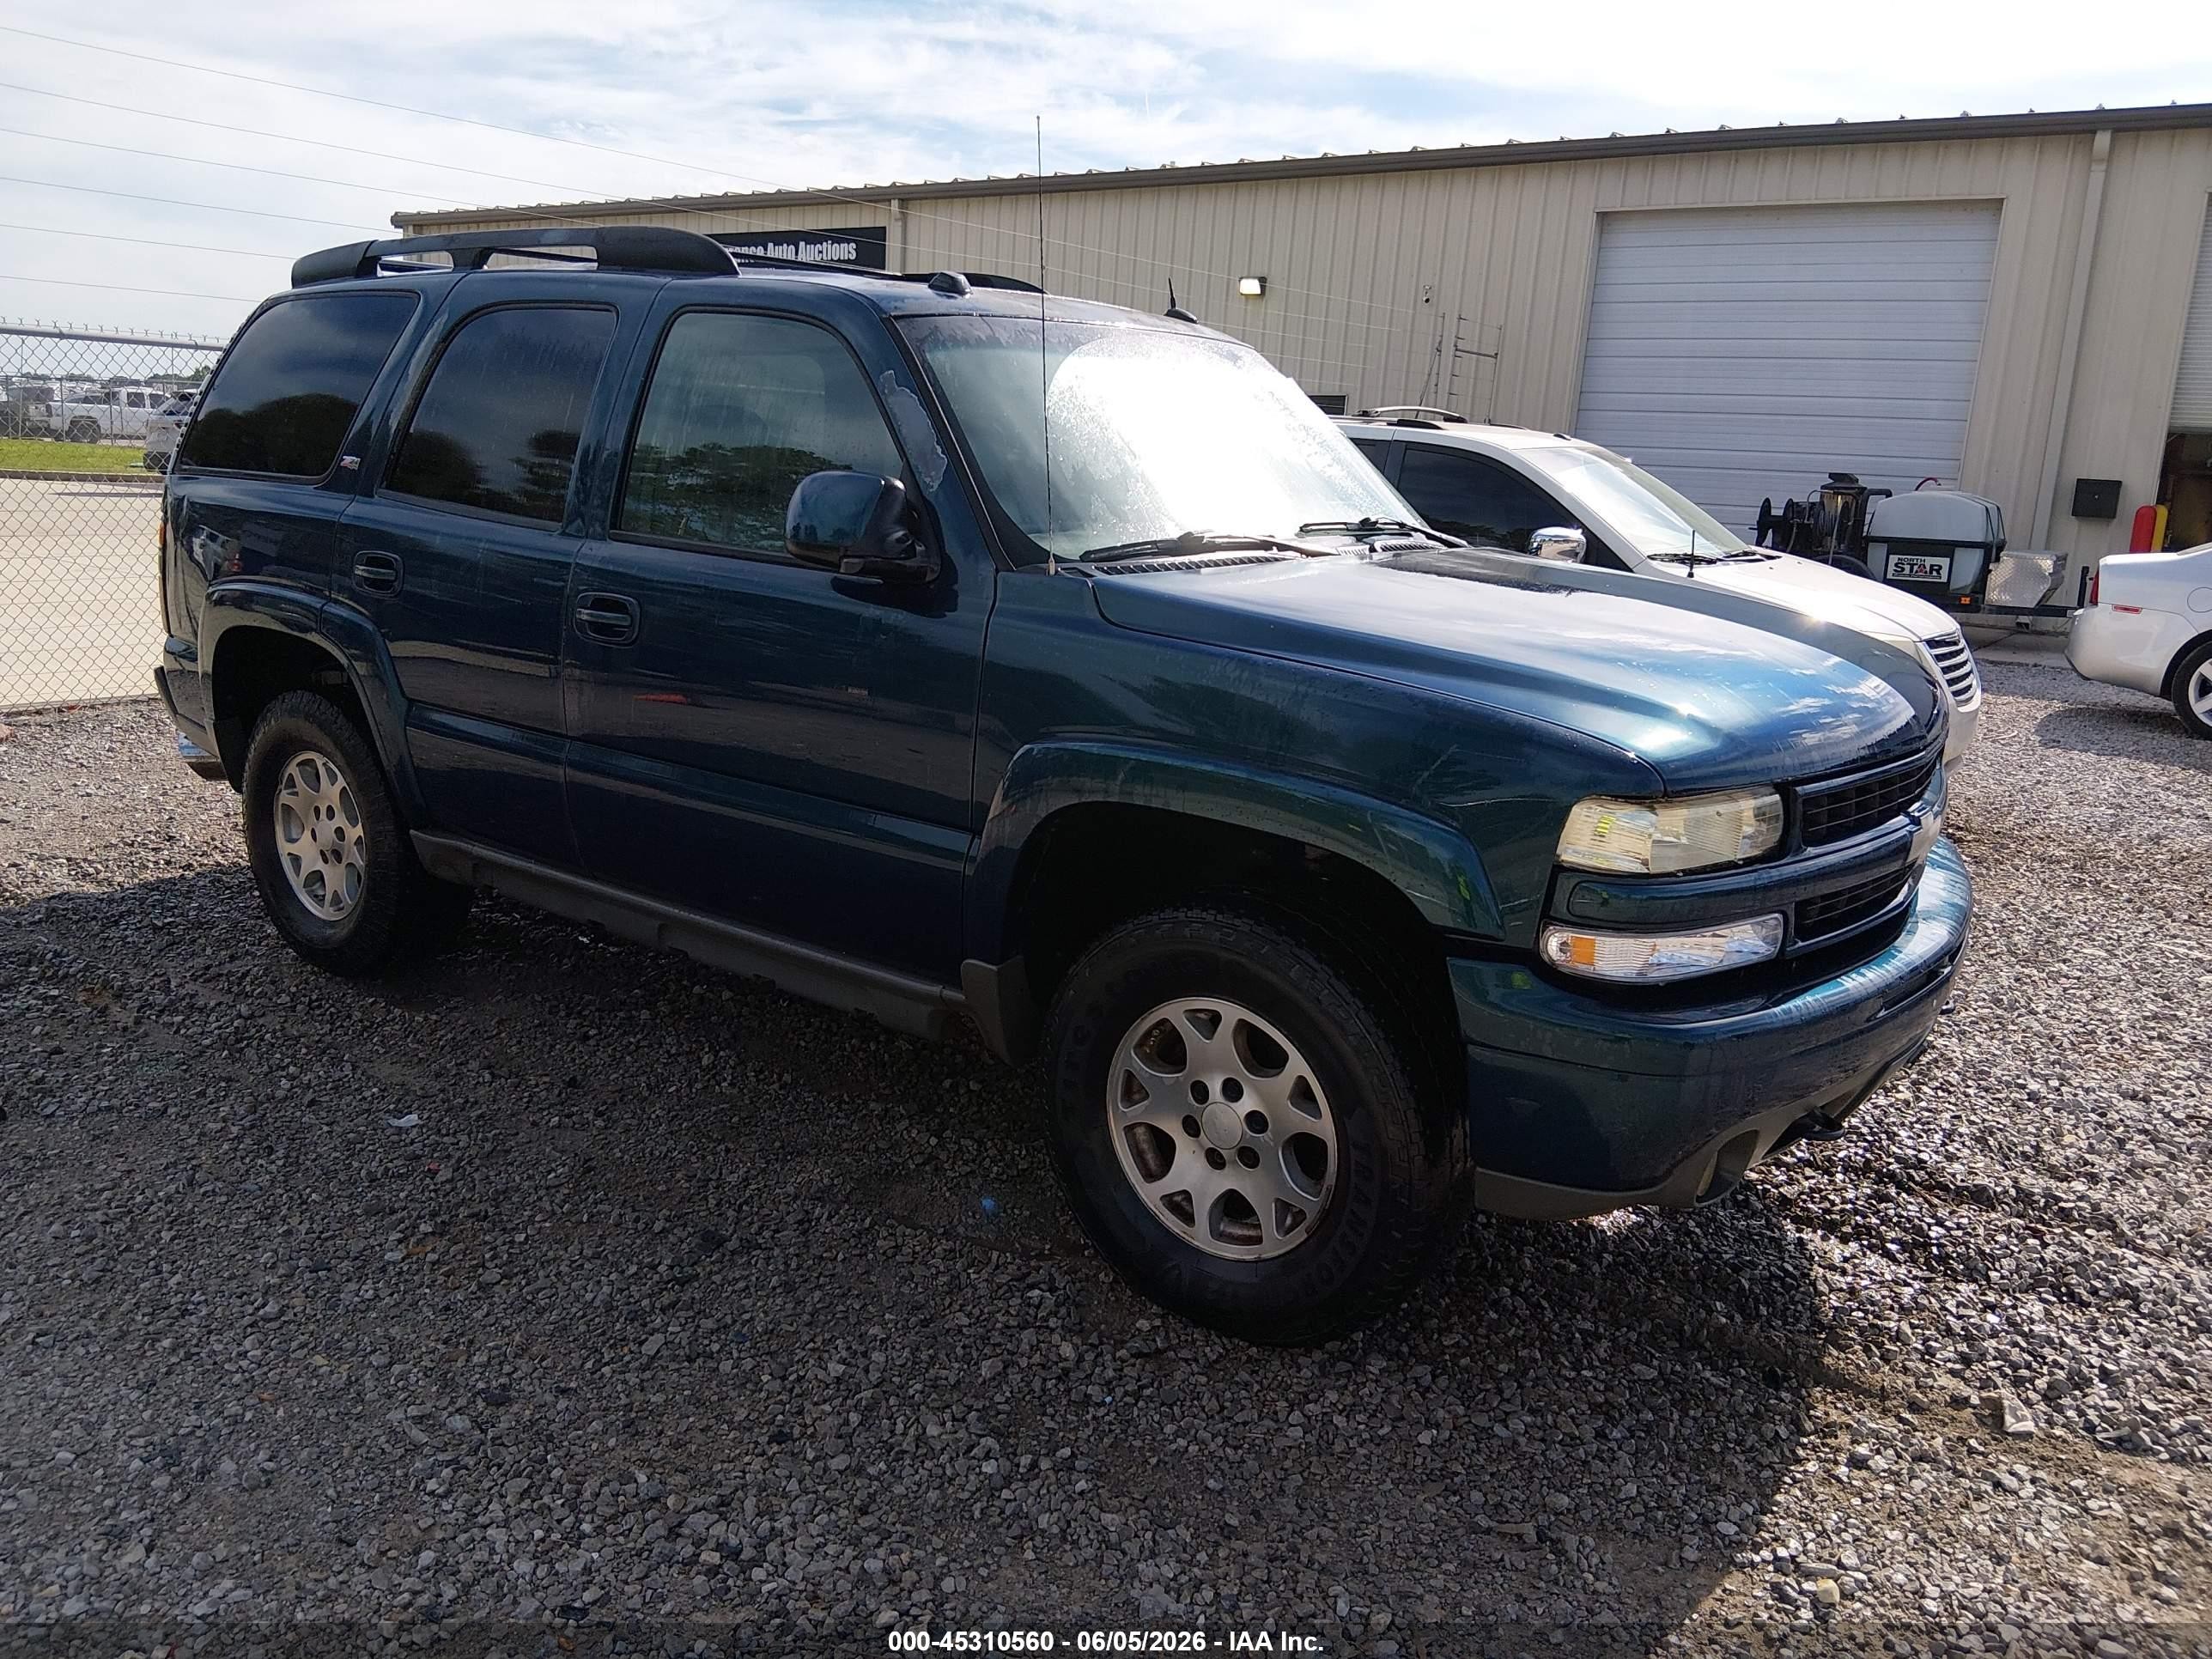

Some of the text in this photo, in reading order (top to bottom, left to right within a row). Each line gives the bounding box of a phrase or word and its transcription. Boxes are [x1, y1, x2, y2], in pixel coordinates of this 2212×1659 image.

[767, 242, 796, 261] Auto
[799, 240, 857, 262] Auctions
[1893, 562, 1943, 576] STAR
